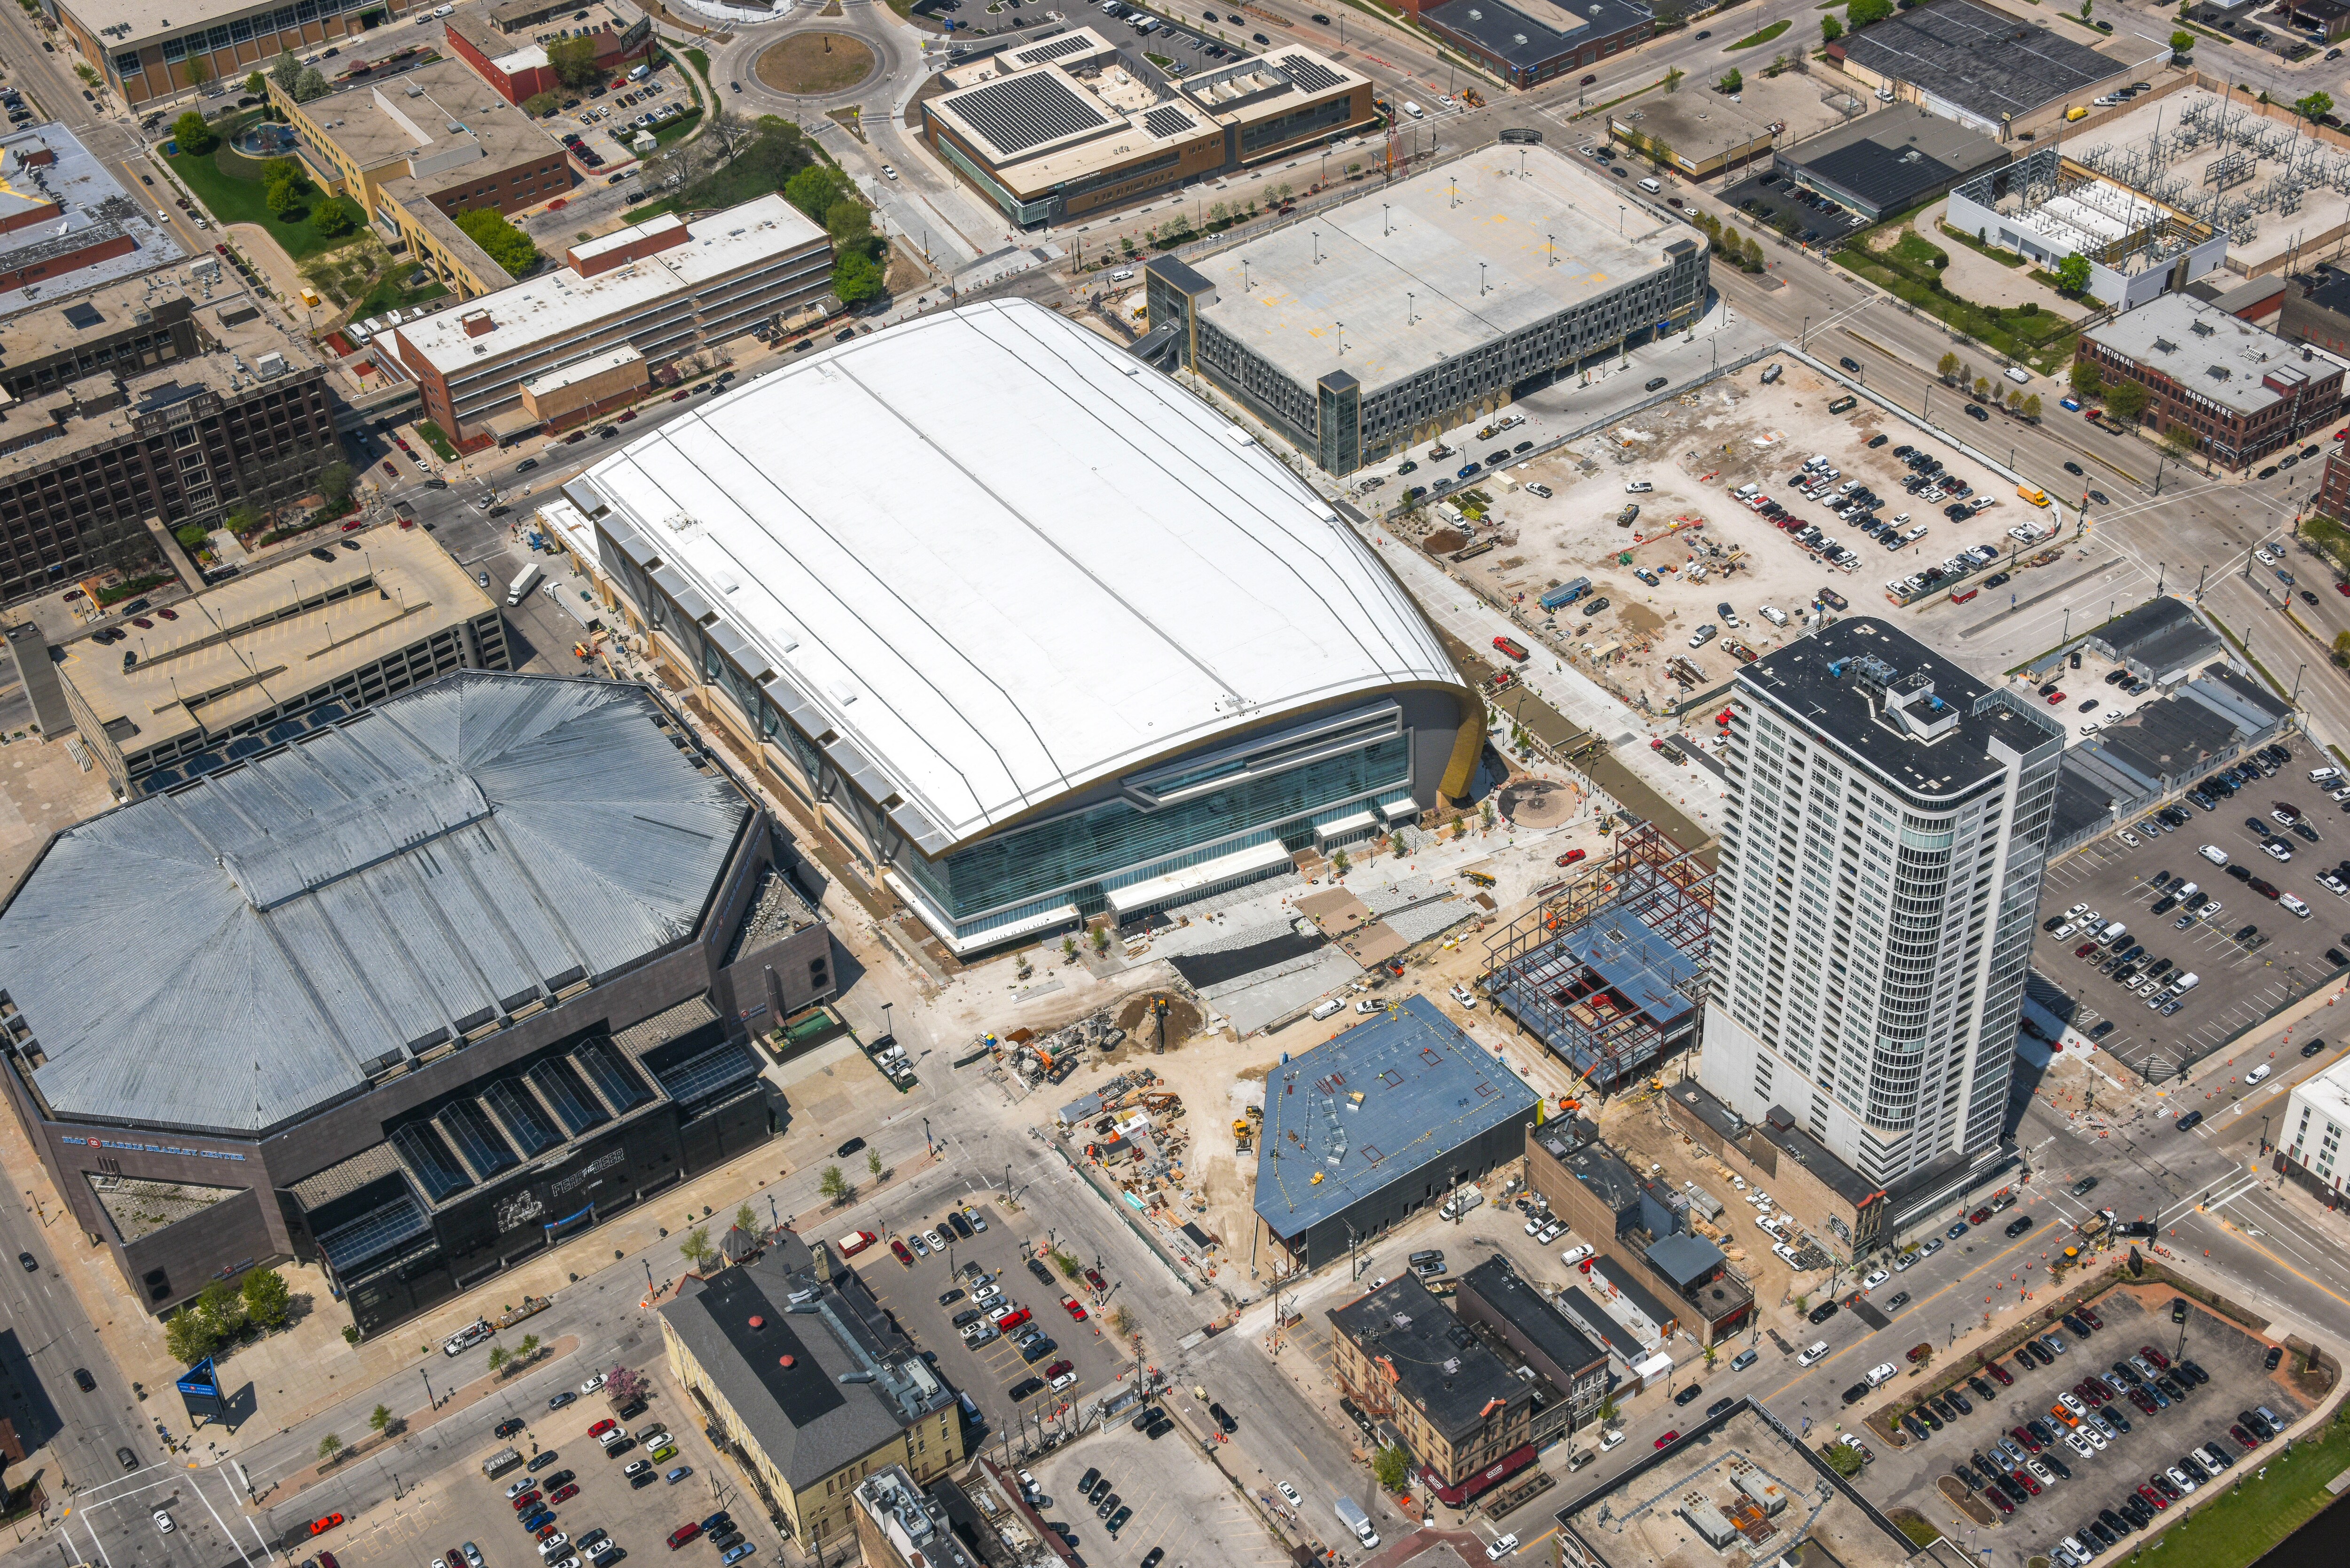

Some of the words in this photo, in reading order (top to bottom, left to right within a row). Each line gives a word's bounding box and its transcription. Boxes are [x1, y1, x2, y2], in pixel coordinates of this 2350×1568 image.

[2096, 343, 2134, 368] NATIONAL
[2185, 389, 2232, 419] HARDWARE
[2290, 386, 2302, 428] HARDWARE
[2215, 443, 2228, 452] NATIONAL
[62, 1136, 87, 1145] BMO
[101, 1140, 144, 1151] HARRIS
[145, 1145, 197, 1156] BRADLEY
[200, 1150, 246, 1161] CENTER
[552, 1169, 585, 1197] FEAR
[581, 1163, 595, 1178] THE
[592, 1148, 624, 1174] DEER
